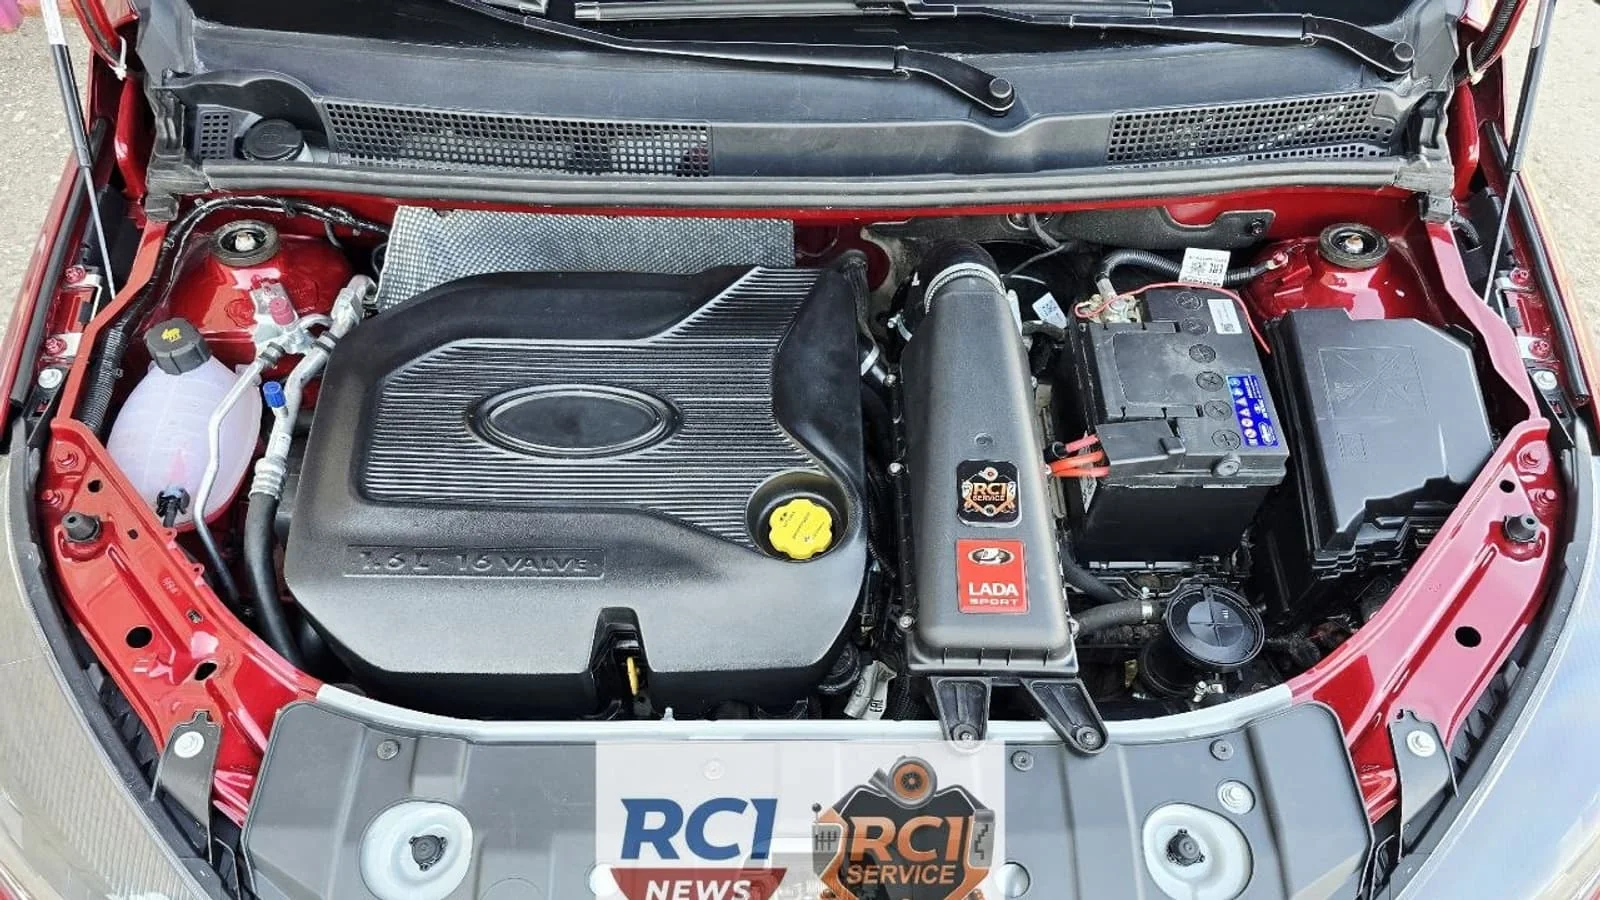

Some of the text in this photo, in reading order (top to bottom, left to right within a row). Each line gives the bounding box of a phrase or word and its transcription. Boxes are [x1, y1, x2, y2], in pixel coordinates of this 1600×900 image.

[972, 482, 1008, 495] RCI
[455, 552, 494, 572] 16
[500, 556, 588, 574] VALVE
[968, 582, 1019, 597] LADA
[969, 598, 1018, 606] SPORT
